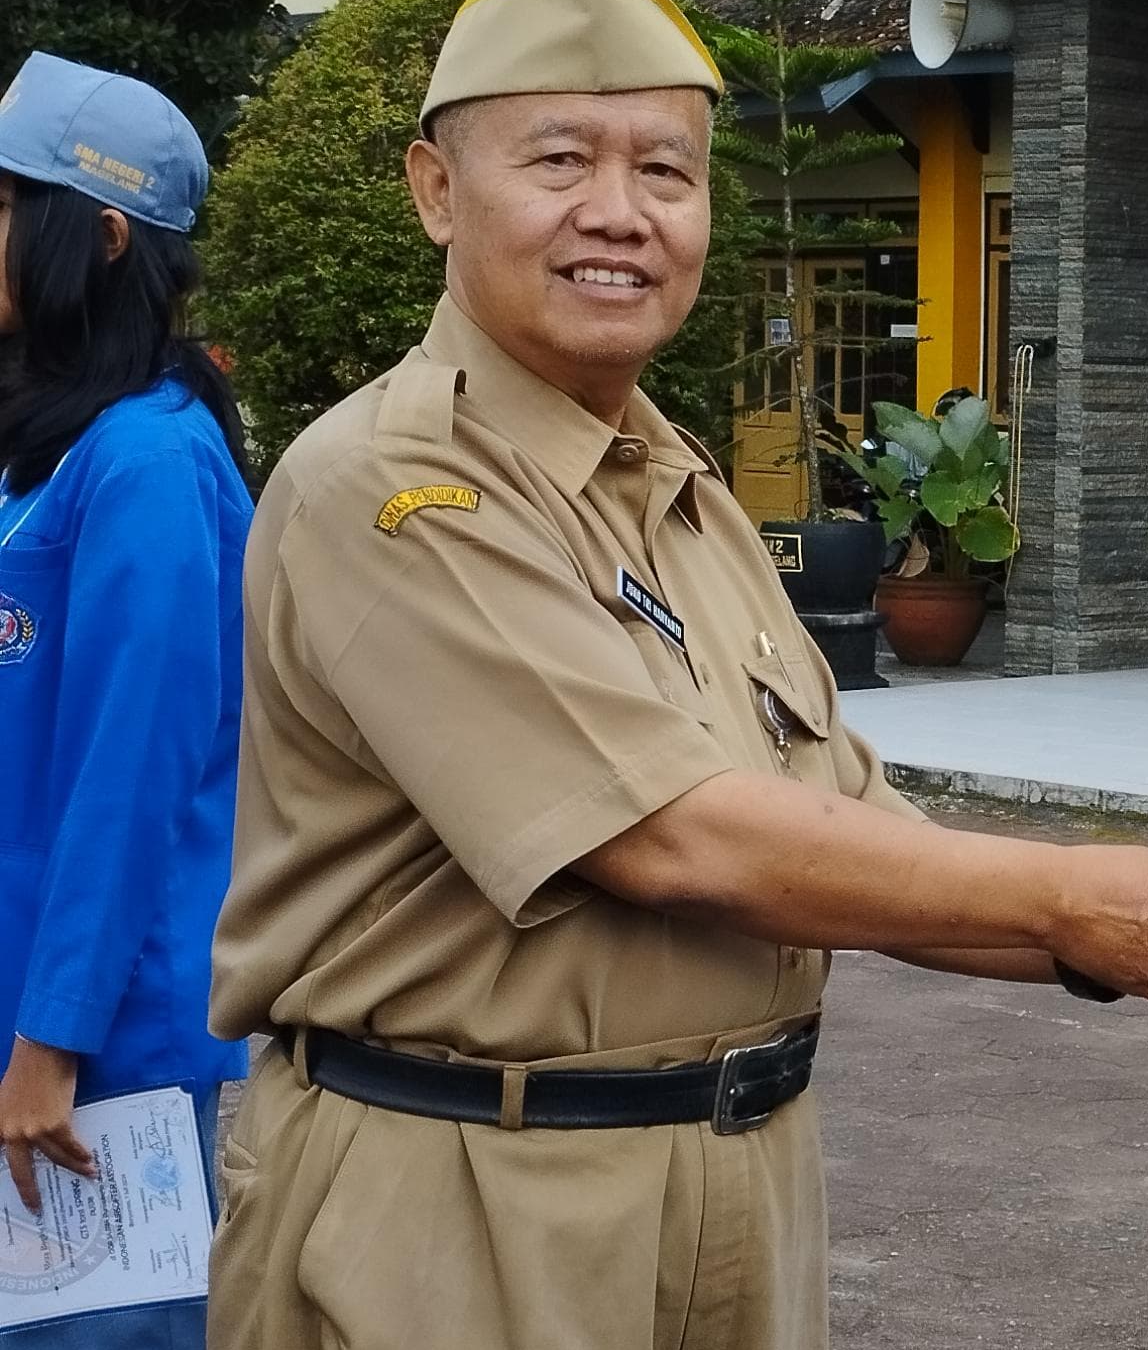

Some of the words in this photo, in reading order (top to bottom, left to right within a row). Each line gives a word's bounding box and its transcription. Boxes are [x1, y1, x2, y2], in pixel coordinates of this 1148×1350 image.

[73, 143, 101, 166] SMA
[102, 157, 145, 184] NEGERI
[145, 176, 156, 190] 2
[79, 161, 140, 194] MAGELANG
[379, 495, 409, 528] DINAS
[408, 488, 476, 507] PENDIDIKAN
[772, 555, 796, 567] ELANG
[775, 539, 784, 554] 2
